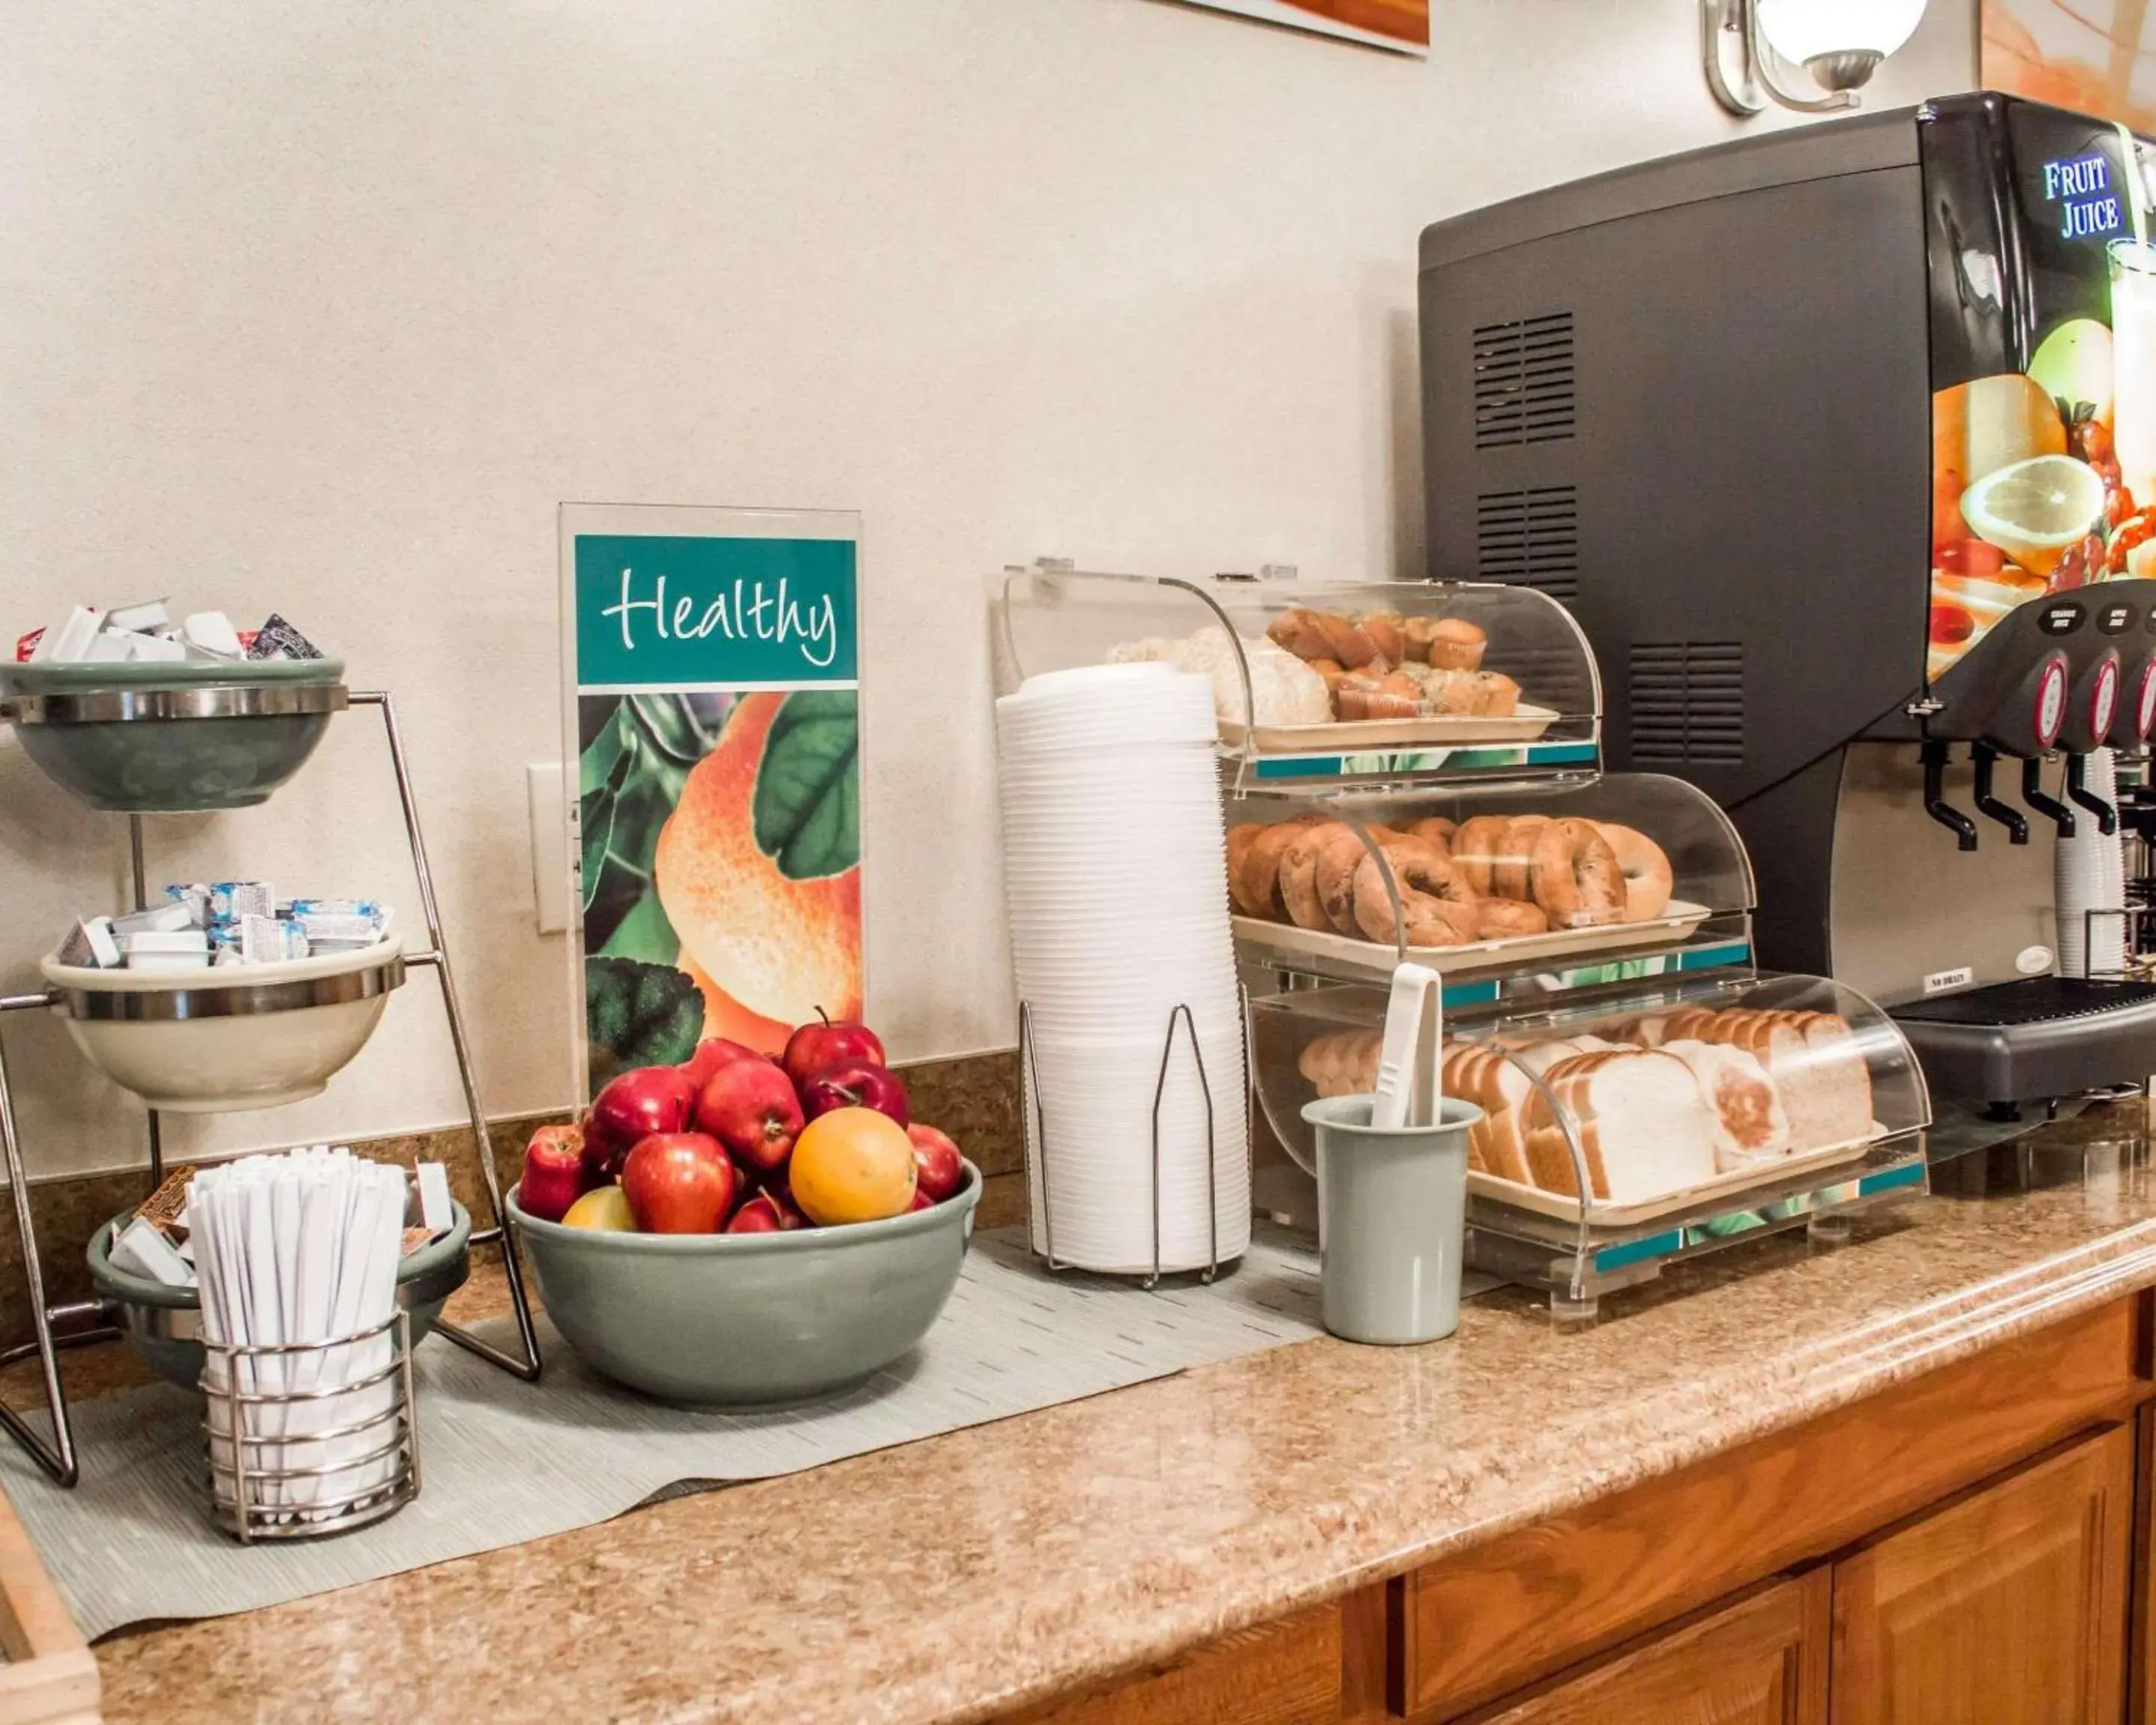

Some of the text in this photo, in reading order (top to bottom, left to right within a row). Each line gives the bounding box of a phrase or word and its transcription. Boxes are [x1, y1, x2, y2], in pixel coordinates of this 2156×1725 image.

[2044, 157, 2105, 200] FRUIT
[2062, 198, 2119, 238] JUICE
[601, 568, 836, 666] Healthy
